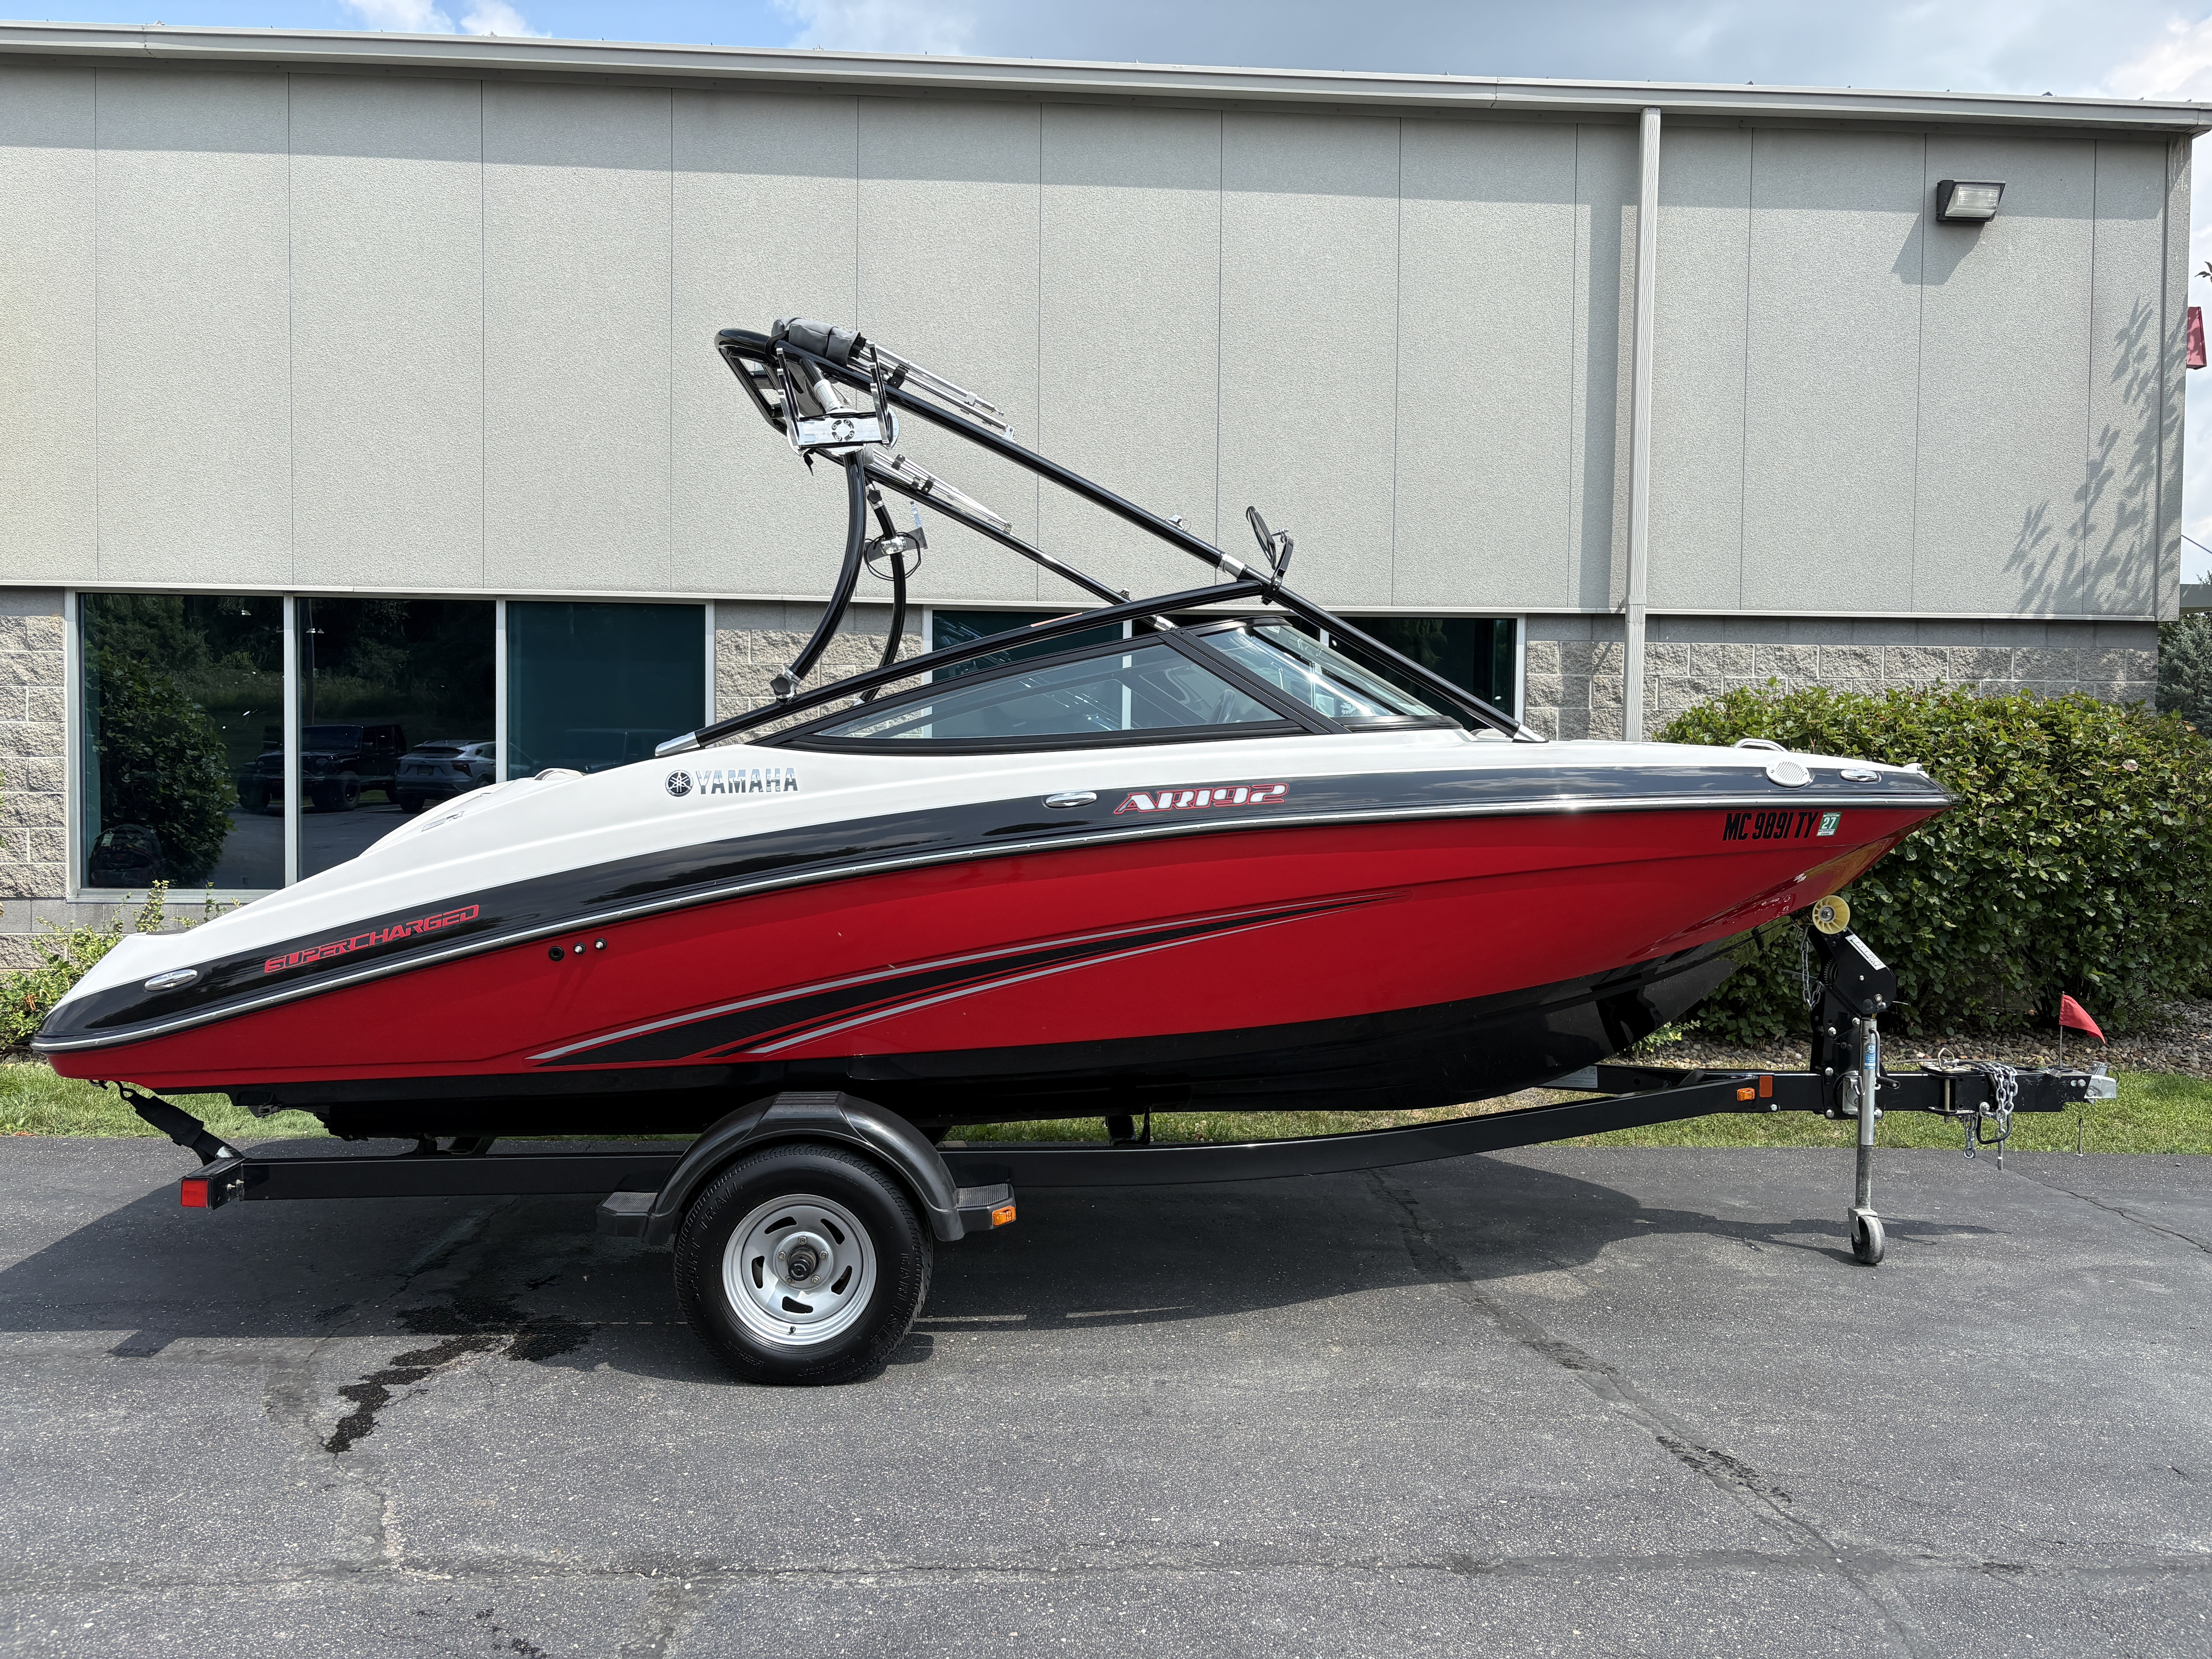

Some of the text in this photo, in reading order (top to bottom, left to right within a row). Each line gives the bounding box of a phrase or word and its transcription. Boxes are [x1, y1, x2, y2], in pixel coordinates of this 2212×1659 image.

[696, 768, 799, 795] YAMAHA
[1113, 782, 1290, 815] AR192
[1722, 812, 1819, 841] MC 9891 TY
[1821, 817, 1837, 829] 27
[264, 904, 479, 974] SUPERCHARGED
[687, 1181, 744, 1304] SPORT TRAIL
[869, 1253, 911, 1350] CARLISLE
